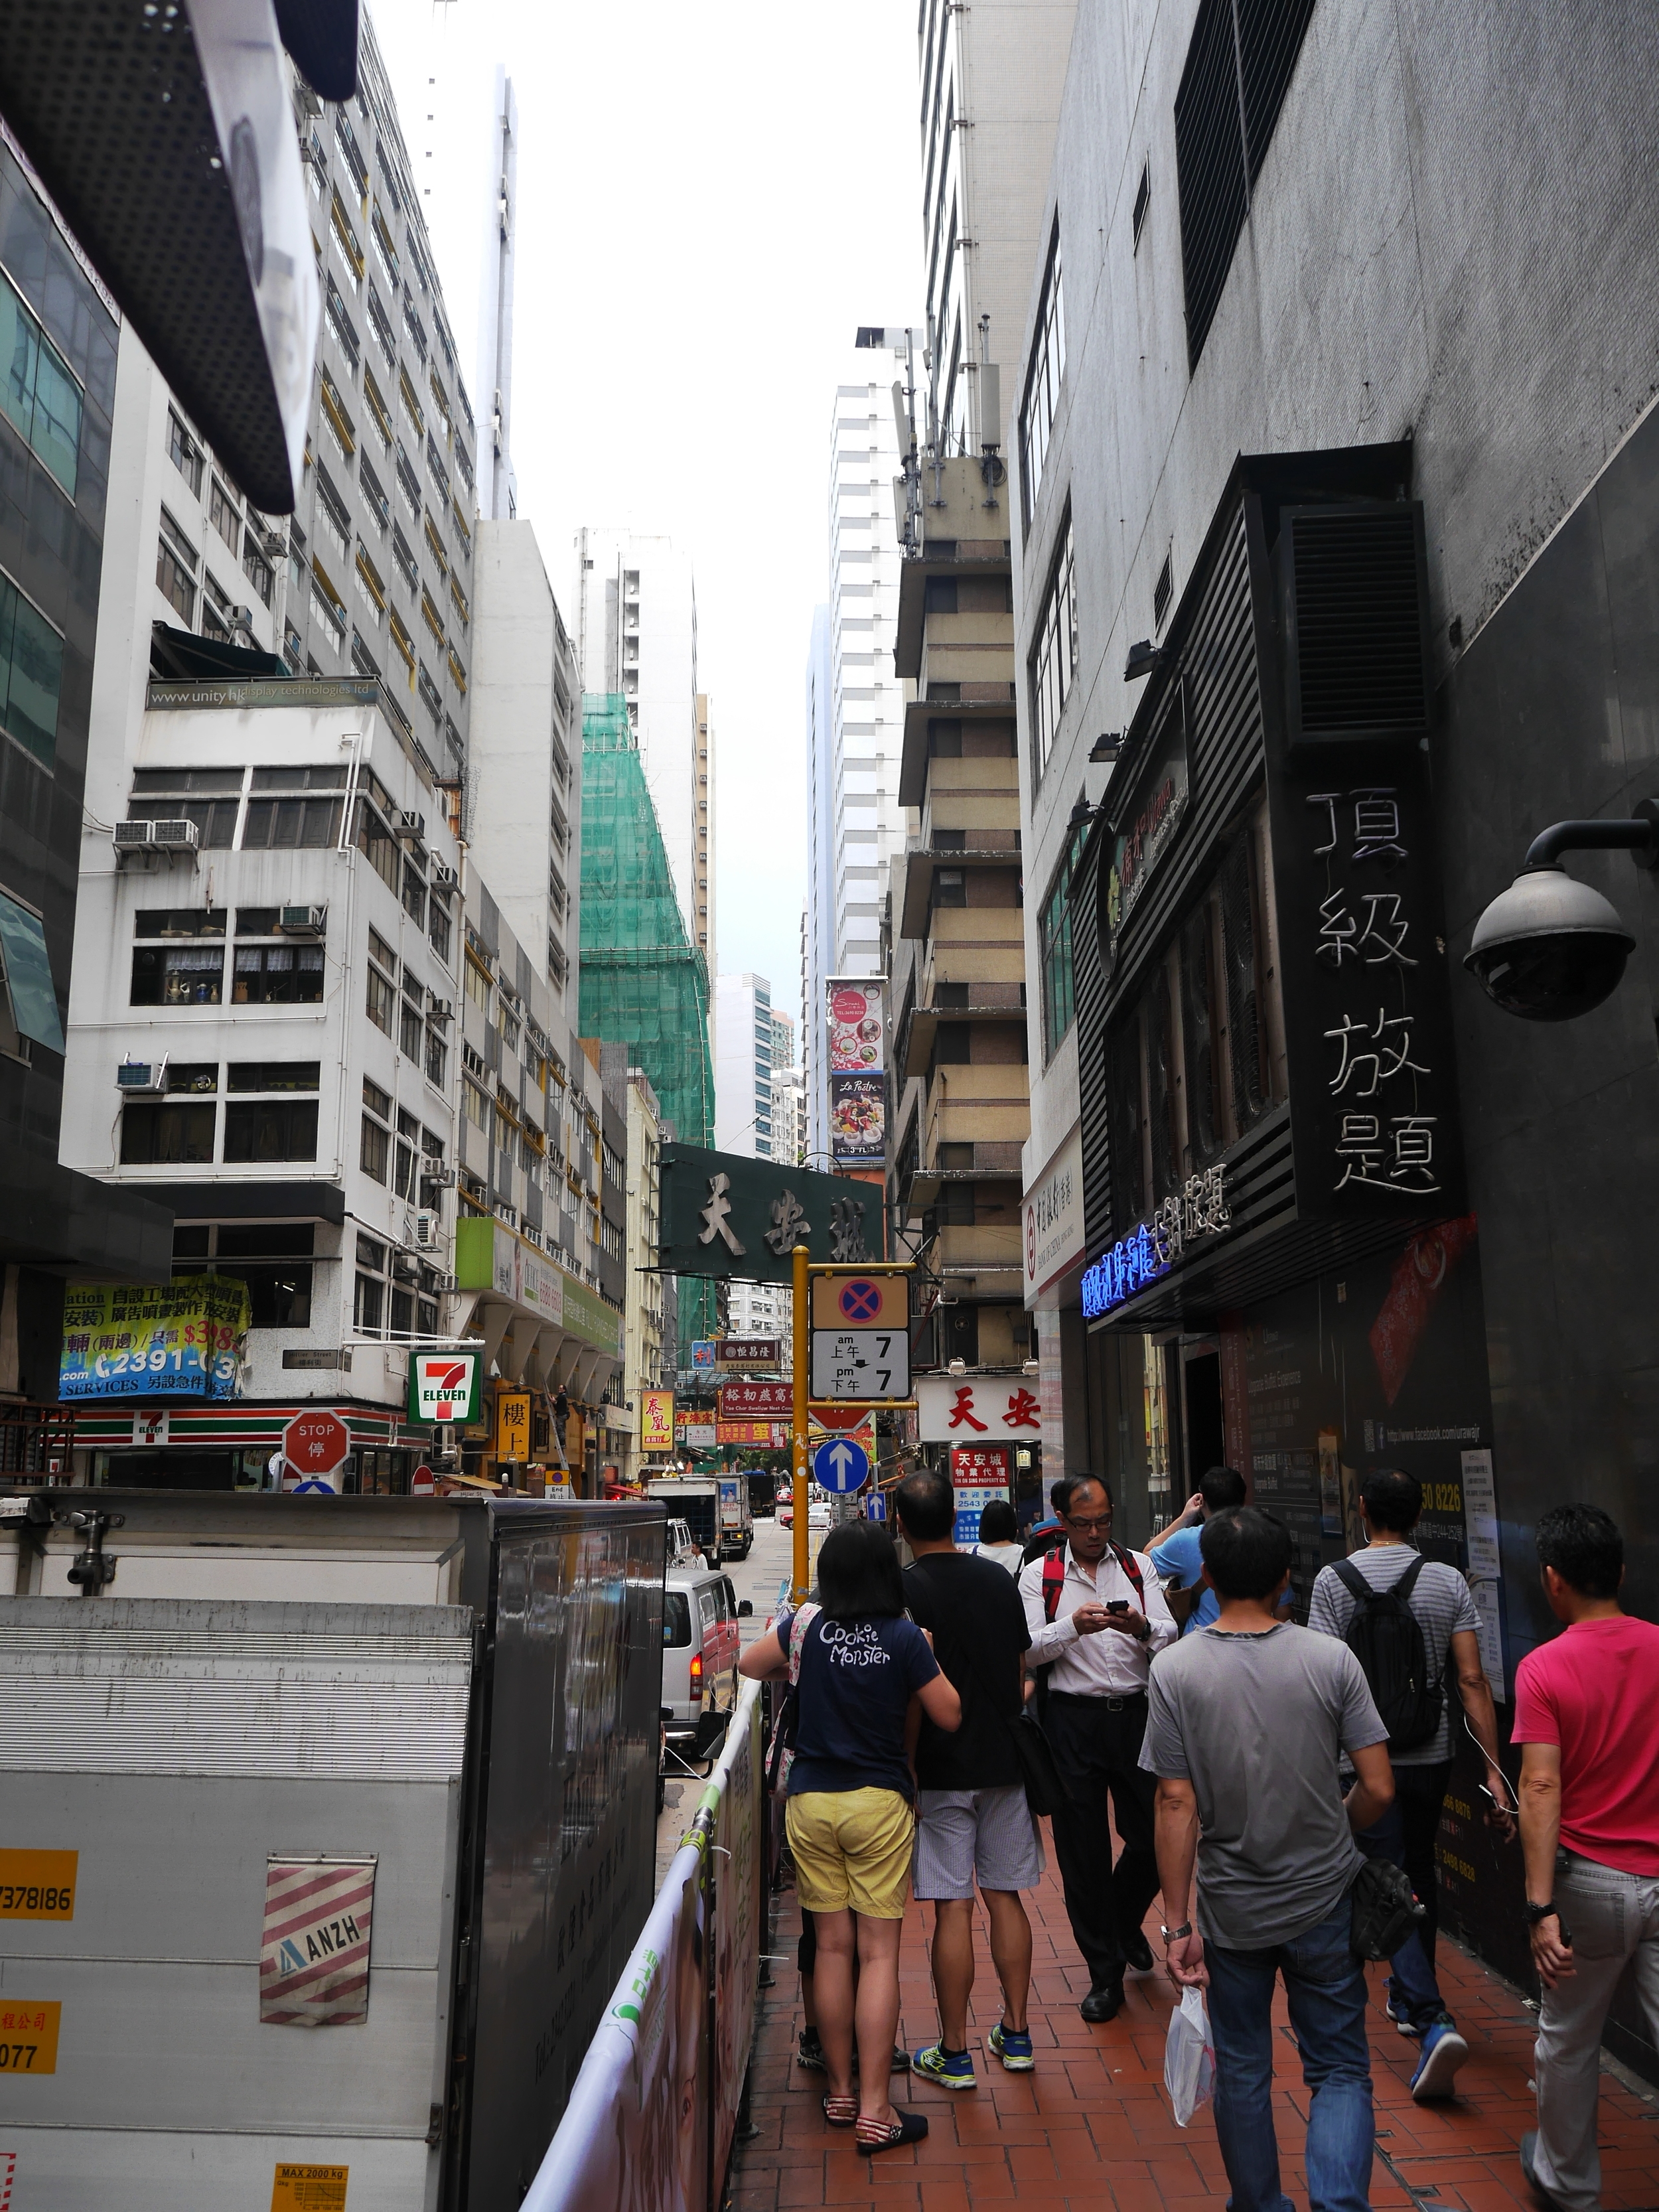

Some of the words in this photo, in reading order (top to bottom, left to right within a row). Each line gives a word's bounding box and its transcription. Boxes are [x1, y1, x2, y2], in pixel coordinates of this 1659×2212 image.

[281, 684, 350, 697] technologies
[354, 684, 369, 694] ltd
[1307, 787, 1441, 1194] 頂級放題
[64, 1291, 105, 1305] ation
[693, 1347, 711, 1365] 利
[737, 1346, 770, 1358] 恒昌隆
[831, 1345, 859, 1359] 上午
[837, 1336, 854, 1345] am
[876, 1337, 892, 1359] 7
[66, 1379, 139, 1396] SERVICES
[831, 1380, 860, 1393] 下午
[837, 1368, 855, 1379] pm
[876, 1370, 892, 1391] 7
[948, 1386, 1041, 1432] 天安
[299, 1425, 334, 1436] STOP
[502, 1402, 526, 1456] 樓上
[308, 1441, 325, 1457] 停
[958, 1453, 1002, 1466] 天安城
[955, 1467, 1005, 1477] 物業代理
[1435, 1483, 1461, 1512] 8226
[820, 1620, 879, 1645] Cookie
[830, 1643, 891, 1666] Monster
[307, 1915, 360, 1962] ANZH
[1, 2012, 45, 2031] 程公司
[282, 2168, 304, 2177] MAX
[307, 2169, 329, 2177] 2000
[332, 2169, 343, 2179] kg
